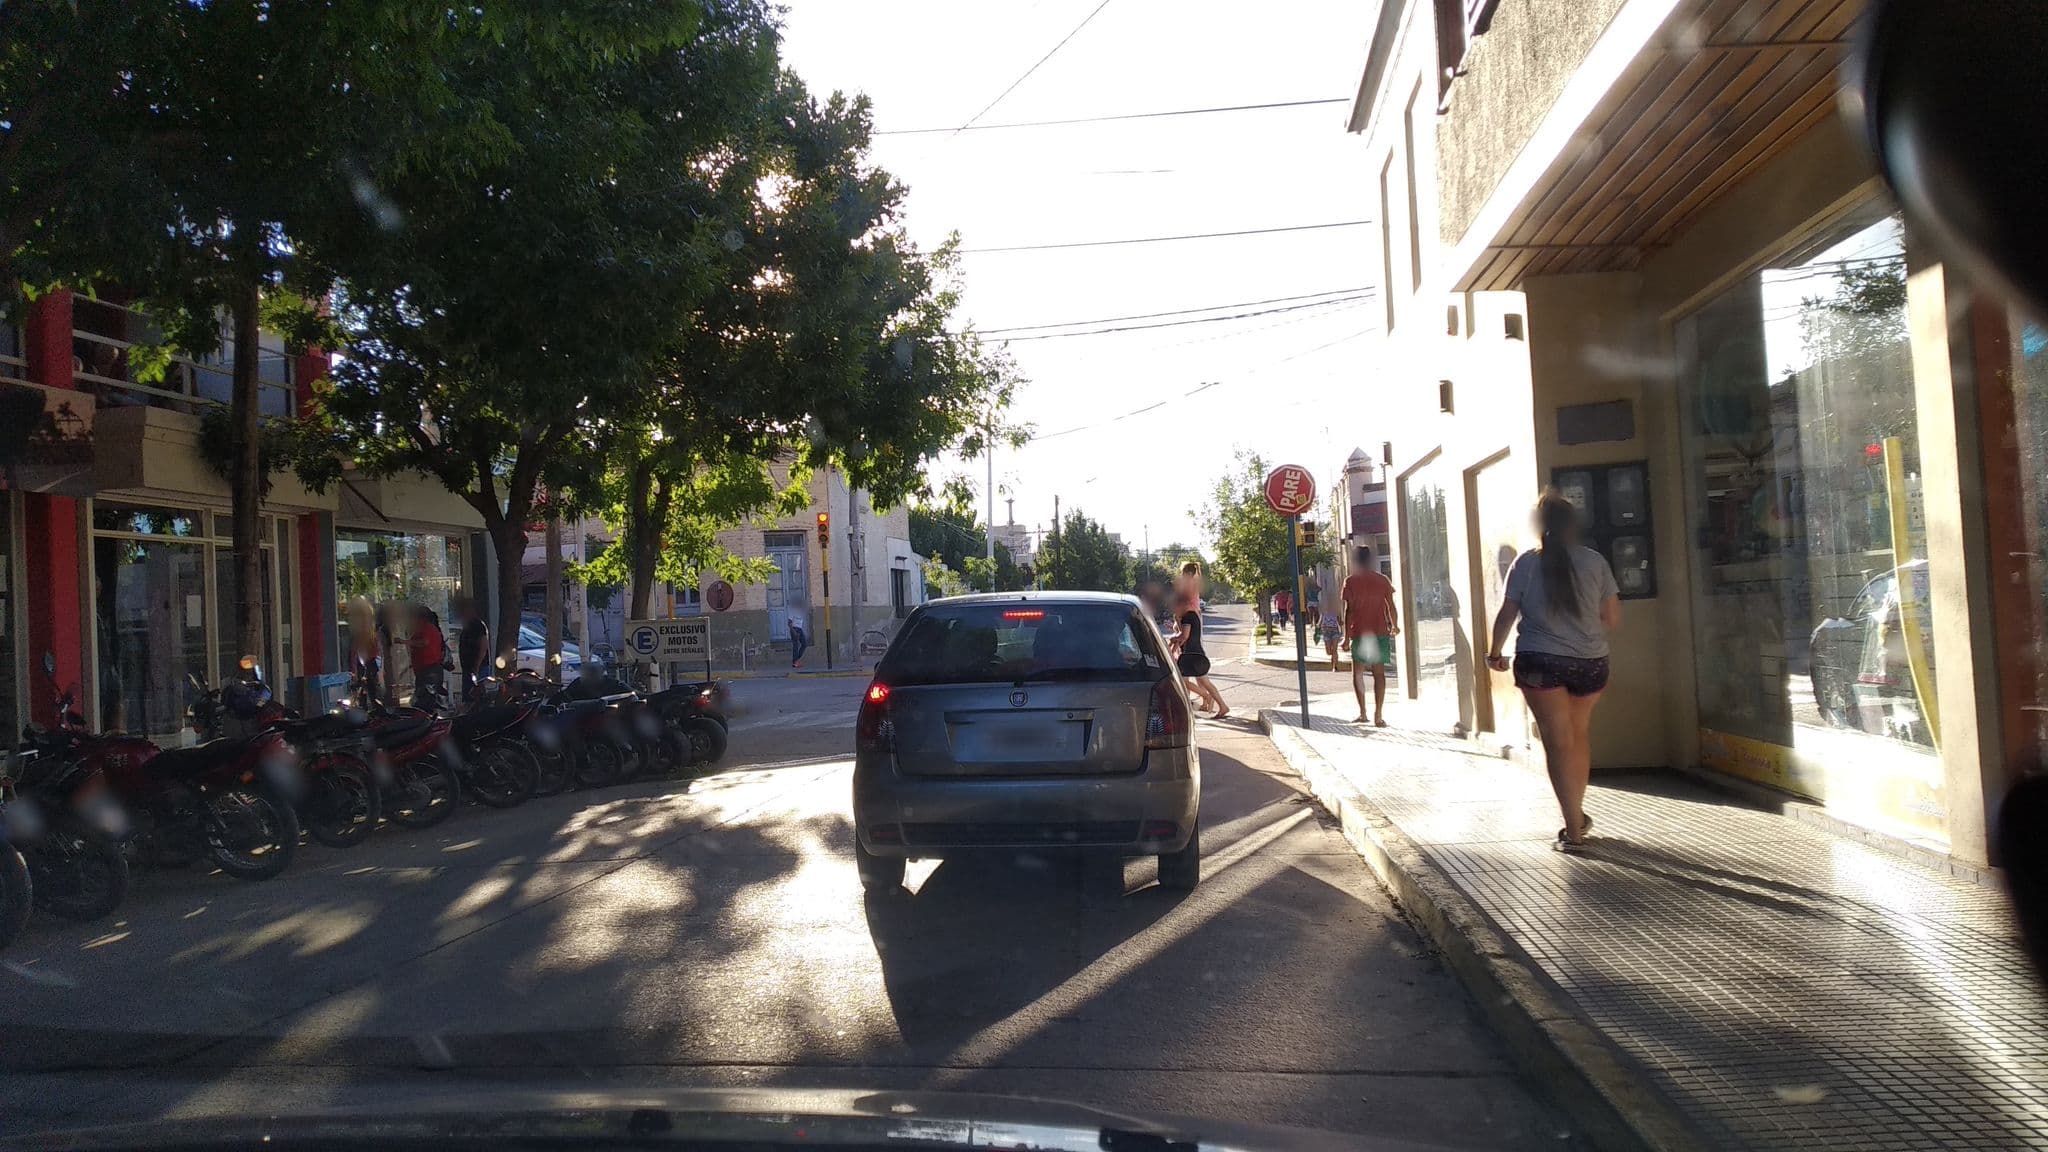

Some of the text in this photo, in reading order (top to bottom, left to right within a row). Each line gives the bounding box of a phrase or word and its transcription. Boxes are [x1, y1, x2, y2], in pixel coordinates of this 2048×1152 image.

[1280, 470, 1301, 507] PARE
[660, 625, 706, 634] EXCLUSIVO
[637, 631, 652, 650] E
[668, 636, 698, 645] MOTOS
